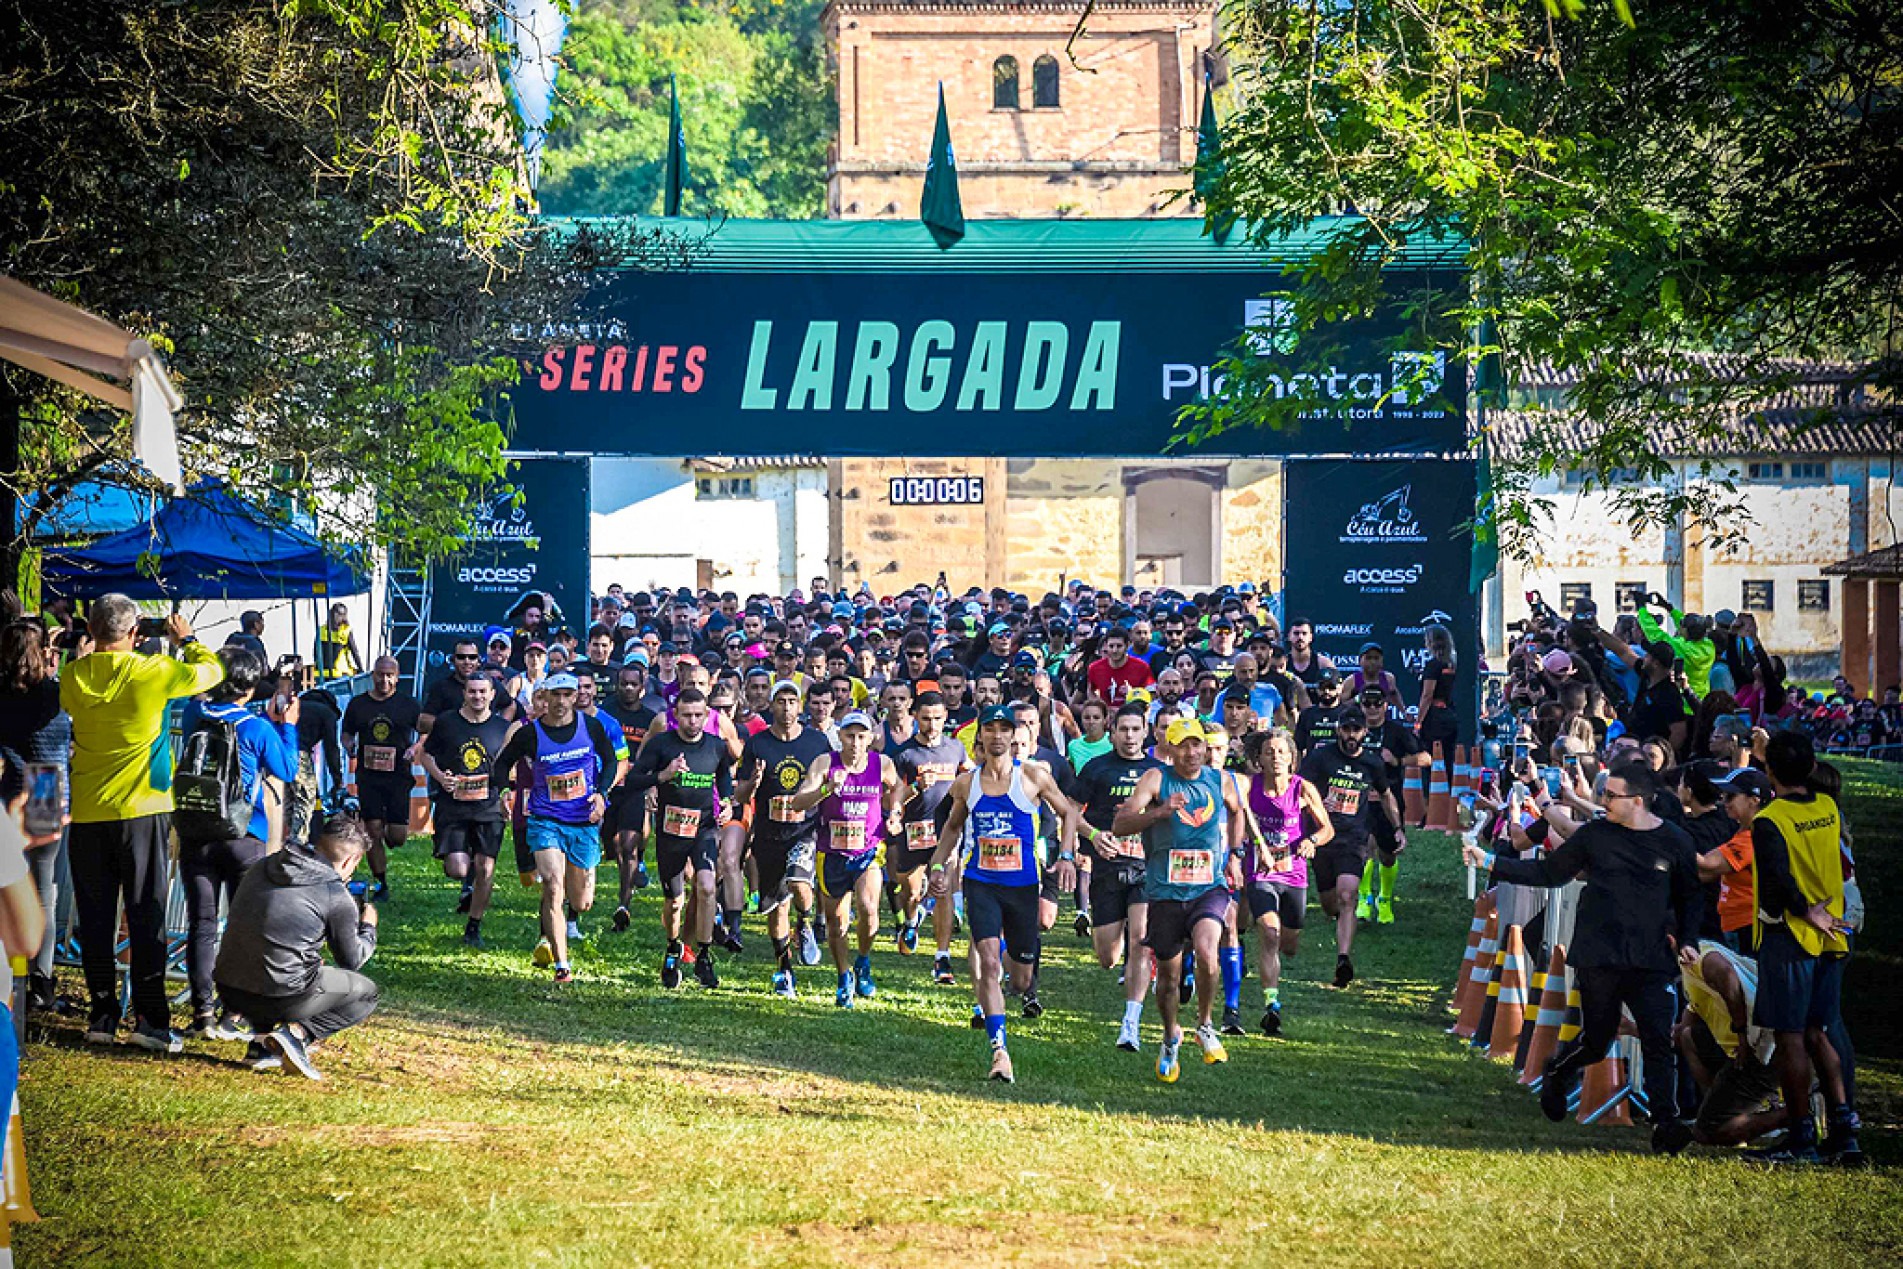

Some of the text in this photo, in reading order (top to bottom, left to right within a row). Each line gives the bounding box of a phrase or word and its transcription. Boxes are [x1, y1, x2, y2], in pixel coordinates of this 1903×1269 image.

[539, 344, 708, 393] SERIES
[740, 319, 1122, 412] LARGADA
[891, 478, 982, 503] 00:00:06
[1378, 519, 1421, 536] Azul
[458, 567, 532, 584] access
[1343, 567, 1418, 584] access
[1394, 625, 1425, 635] Arcelor
